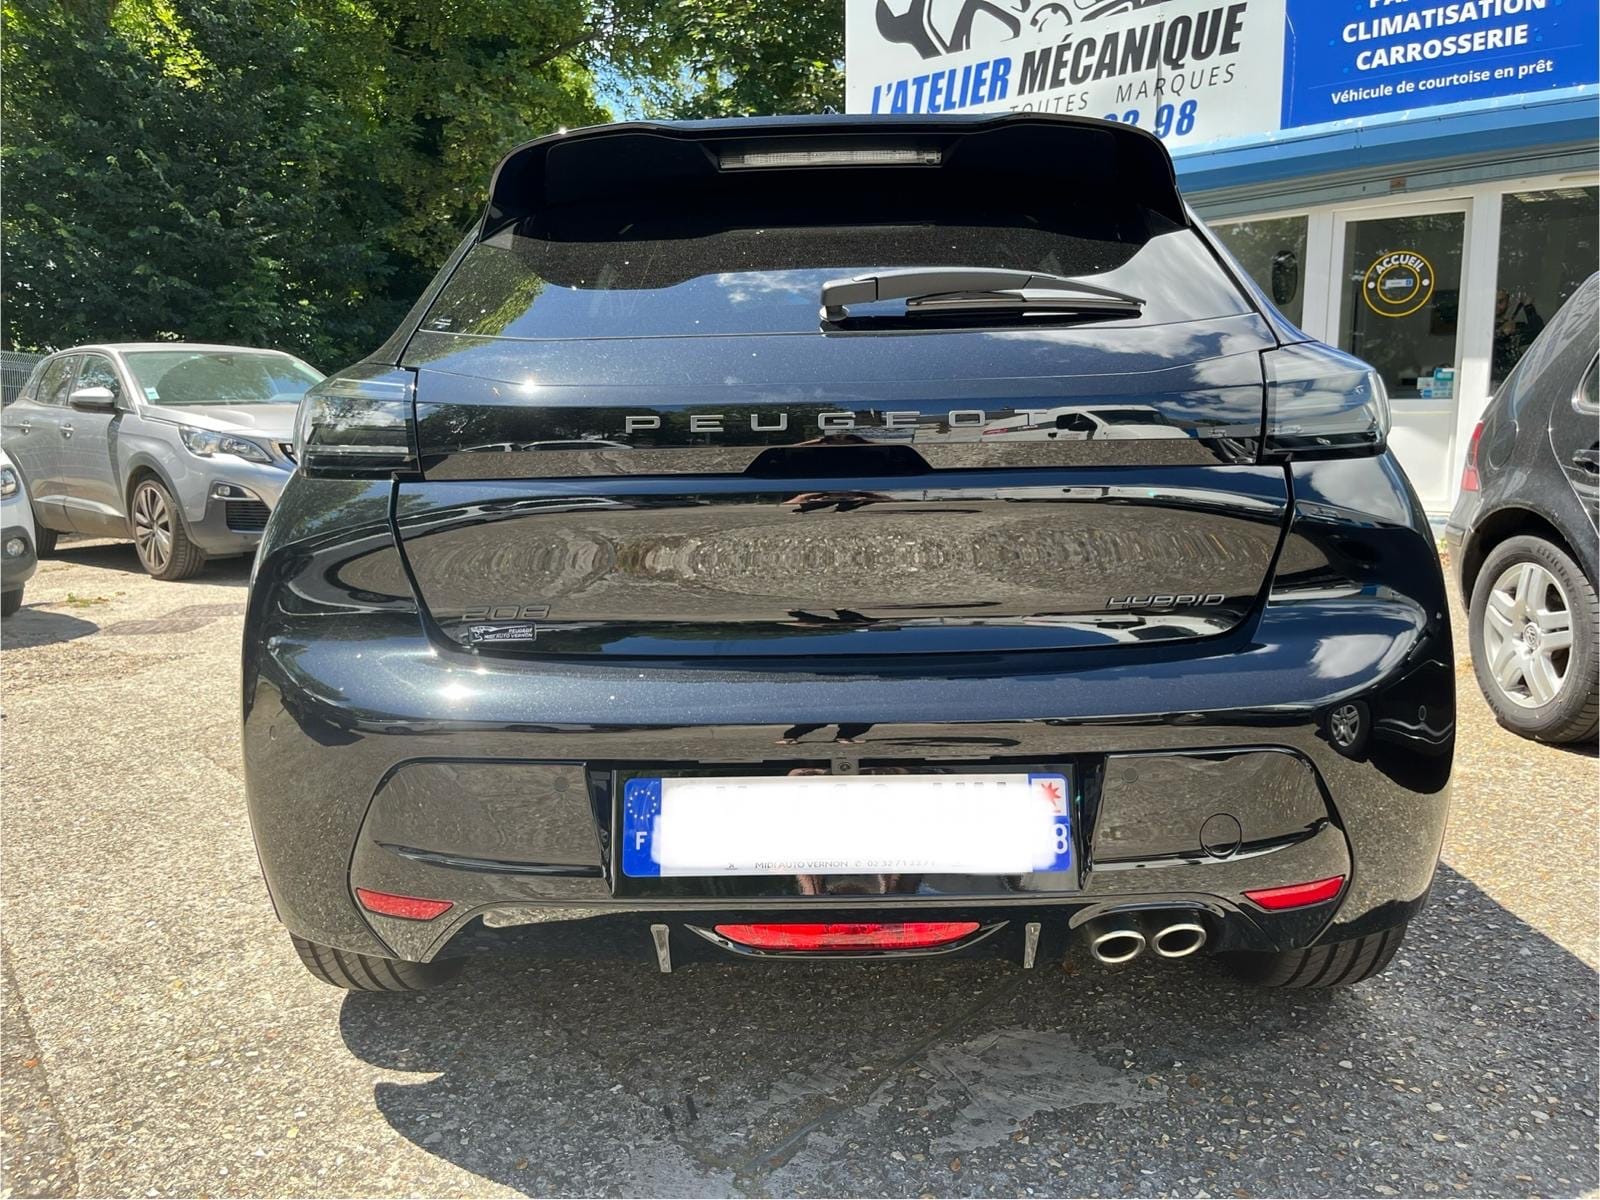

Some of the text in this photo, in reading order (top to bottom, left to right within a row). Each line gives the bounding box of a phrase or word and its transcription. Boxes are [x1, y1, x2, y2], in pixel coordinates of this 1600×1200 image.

[1017, 2, 1248, 97] MÉCANIQUE
[1356, 24, 1529, 71] CARROSSERIE
[1115, 63, 1237, 104] MARQUES
[1331, 59, 1554, 105] Véhicule de courtoise en prêt
[1154, 99, 1199, 140] 98
[1375, 254, 1425, 275] ACCUEIL
[625, 408, 1048, 434] PEUGEOT
[462, 604, 551, 621] 208
[1105, 593, 1225, 609] HYBRID
[635, 831, 648, 850] F
